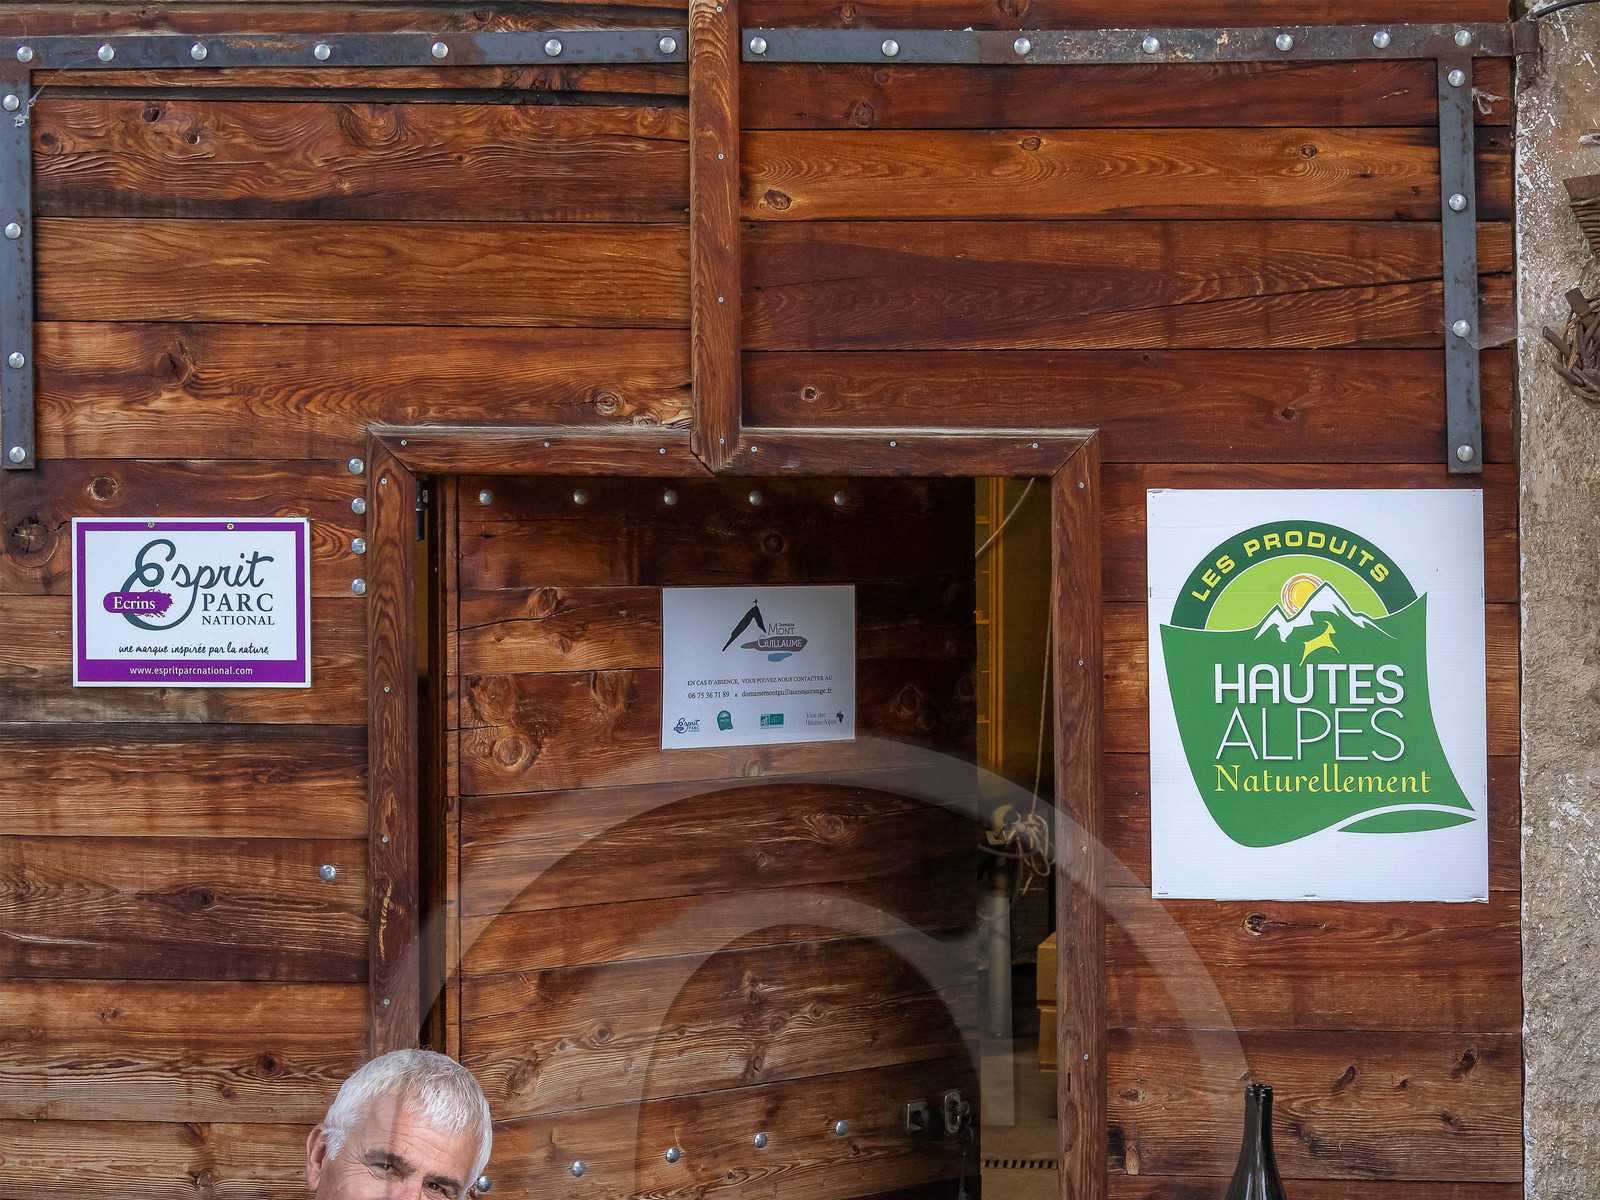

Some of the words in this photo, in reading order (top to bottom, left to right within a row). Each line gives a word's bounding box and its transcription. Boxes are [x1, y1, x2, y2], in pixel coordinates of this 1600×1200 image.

[1192, 554, 1236, 602] LES
[1243, 530, 1389, 584] PRODUITS
[120, 538, 274, 631] Esprit
[113, 596, 156, 610] Ecrins
[201, 593, 274, 612] PARC
[201, 615, 275, 626] NATIONAL
[118, 645, 133, 653] une
[135, 645, 168, 656] marque
[171, 643, 207, 657] inspirée
[208, 646, 226, 657] par
[227, 641, 237, 654] la
[757, 635, 803, 648] GUILLAUME
[129, 666, 253, 676] www.espritparcnational.com
[1214, 662, 1405, 704] HAUTES
[1215, 706, 1406, 761] ALPES
[1213, 763, 1432, 793] Naturellement
